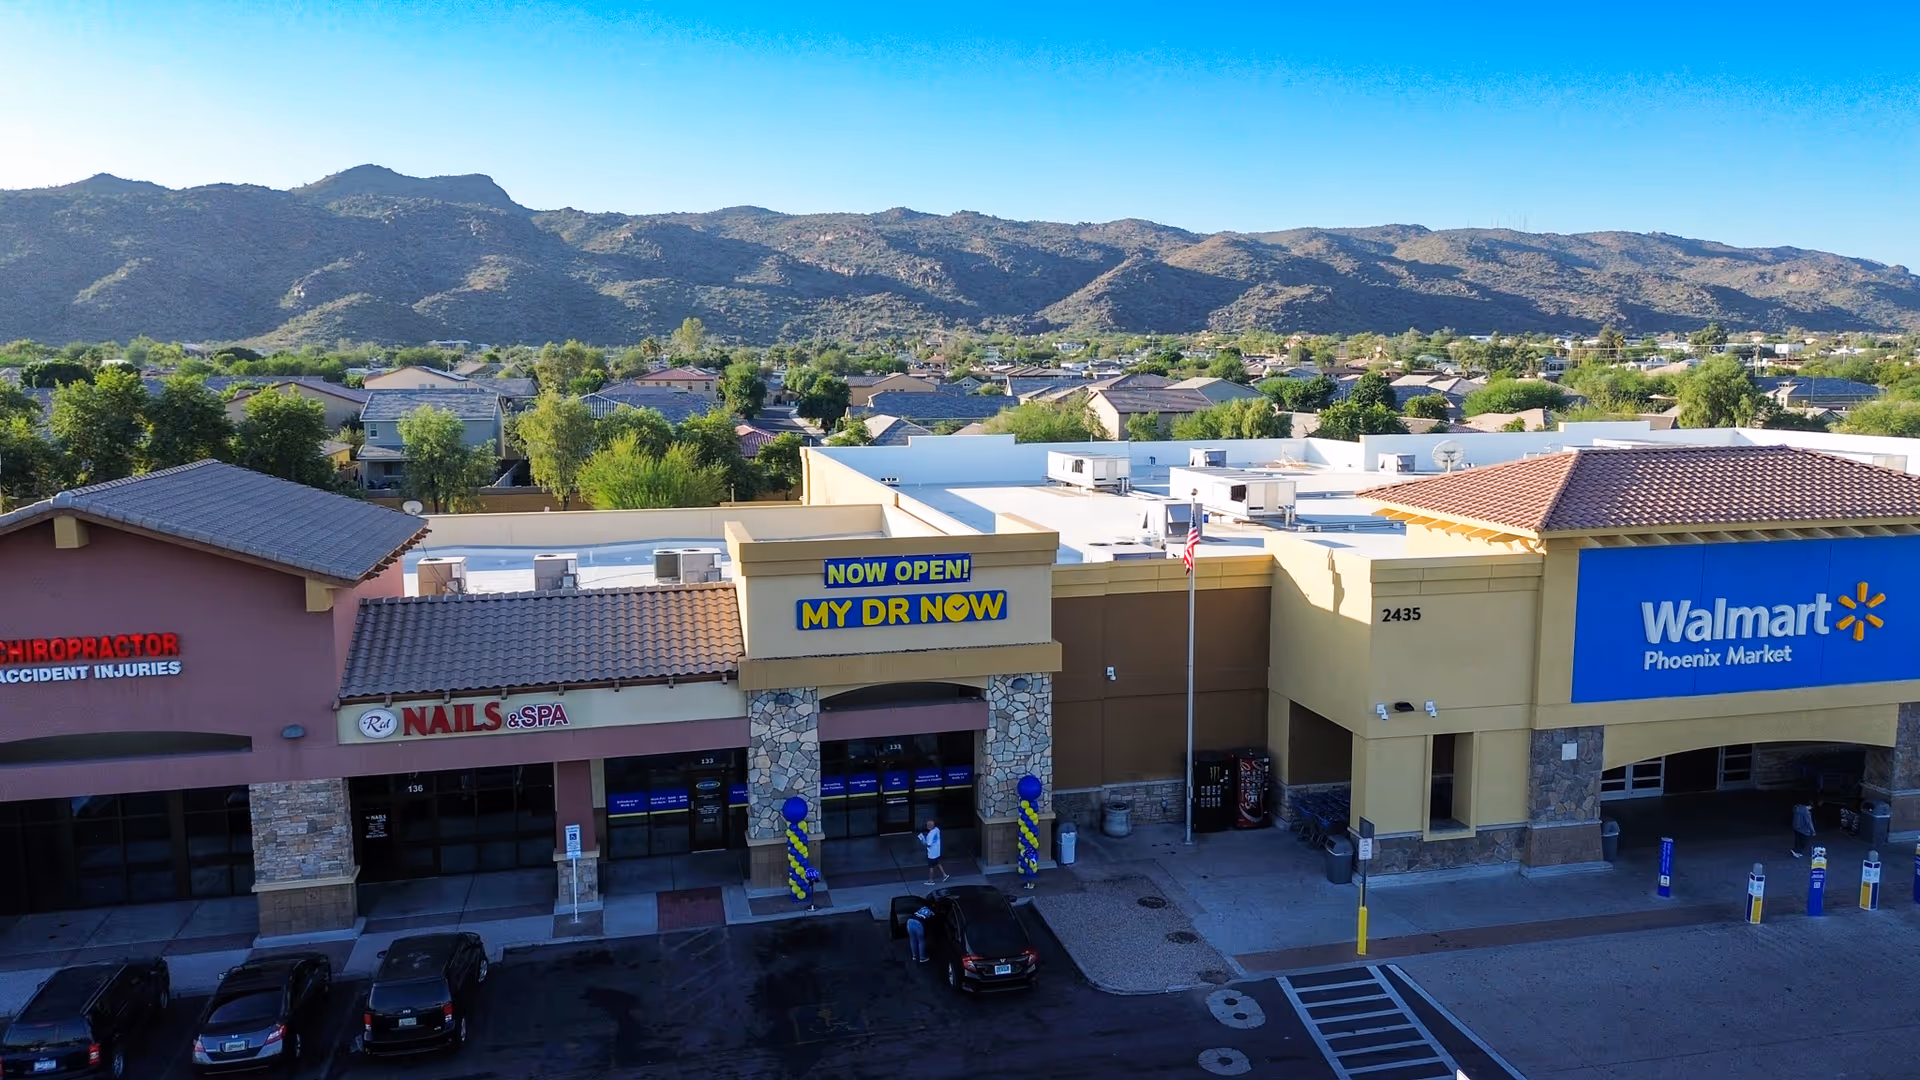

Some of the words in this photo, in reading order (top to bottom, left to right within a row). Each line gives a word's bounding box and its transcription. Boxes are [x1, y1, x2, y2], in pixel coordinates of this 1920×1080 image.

[828, 563, 887, 584] NOW
[895, 559, 969, 581] OPEN!
[802, 600, 852, 629] MY
[862, 597, 910, 626] DR
[920, 593, 1004, 623] NOW
[1382, 607, 1422, 622] 2435
[1642, 593, 1832, 644] Walmart
[94, 661, 182, 679] INJURIES
[1644, 648, 1721, 670] Phoenix
[1726, 644, 1793, 666] Market
[401, 701, 503, 737] NAILS
